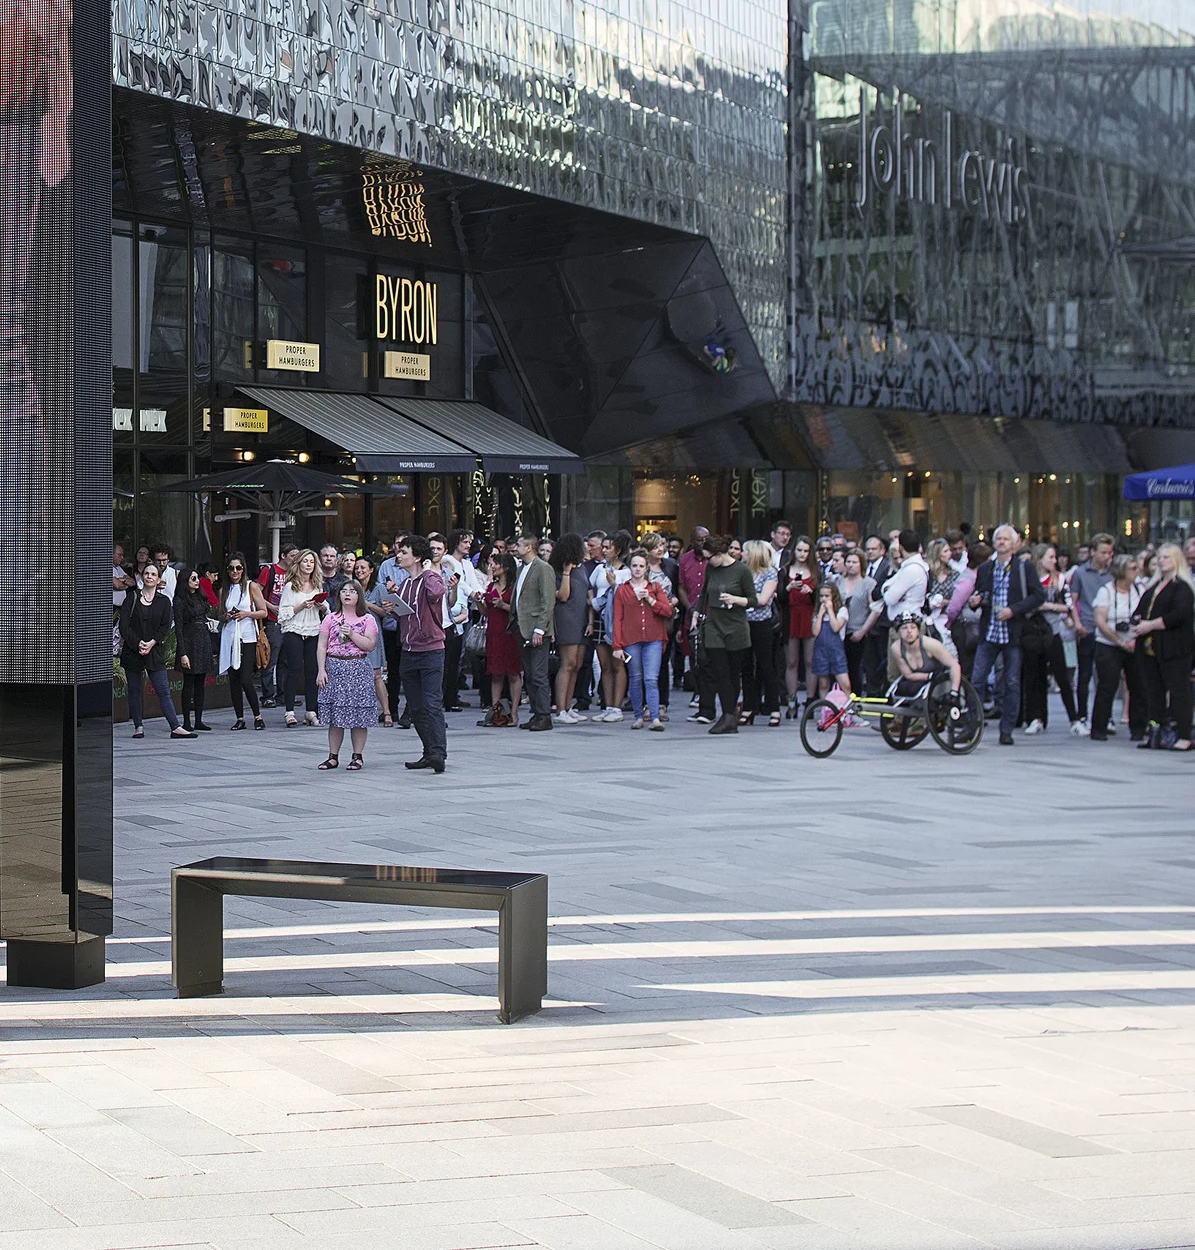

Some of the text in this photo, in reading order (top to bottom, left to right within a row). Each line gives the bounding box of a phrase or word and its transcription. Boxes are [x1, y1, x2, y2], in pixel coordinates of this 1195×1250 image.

[376, 273, 437, 345] BYRON
[285, 345, 307, 356] PROPER
[278, 356, 316, 368] HAMBURGERS
[401, 355, 419, 366] PROPER
[395, 367, 427, 377] HAMBURGERS
[240, 411, 258, 421] PROPER
[234, 420, 265, 430] HAMBURGERS
